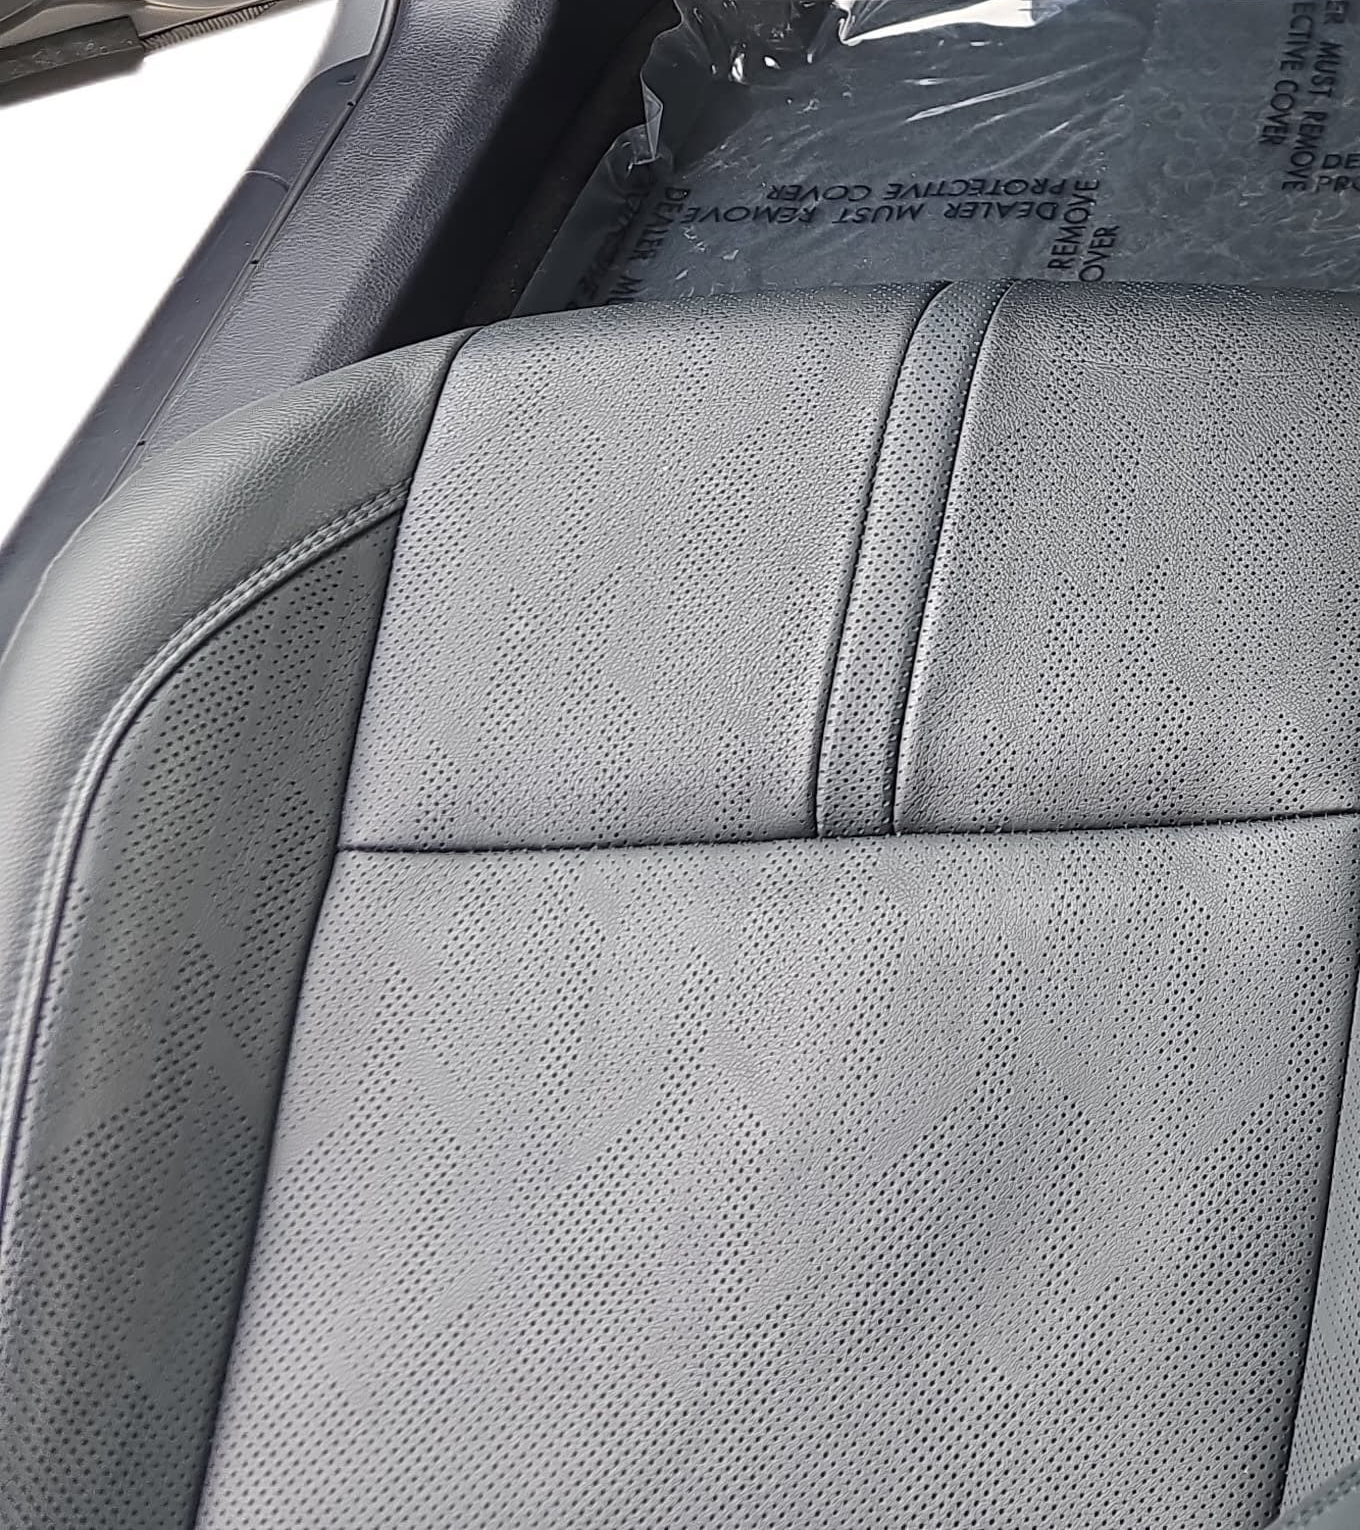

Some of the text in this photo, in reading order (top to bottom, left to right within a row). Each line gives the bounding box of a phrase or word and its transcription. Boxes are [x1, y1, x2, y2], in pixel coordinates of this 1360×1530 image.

[1308, 41, 1344, 99] MUST
[1258, 80, 1299, 146] COVER
[1281, 110, 1329, 191] REMOVE
[681, 201, 1060, 224] DEALER MUST REMOVE
[766, 178, 1073, 202] PROTECTIVE COVER
[1046, 179, 1100, 270] REMOVE
[1079, 224, 1121, 283] OVER
